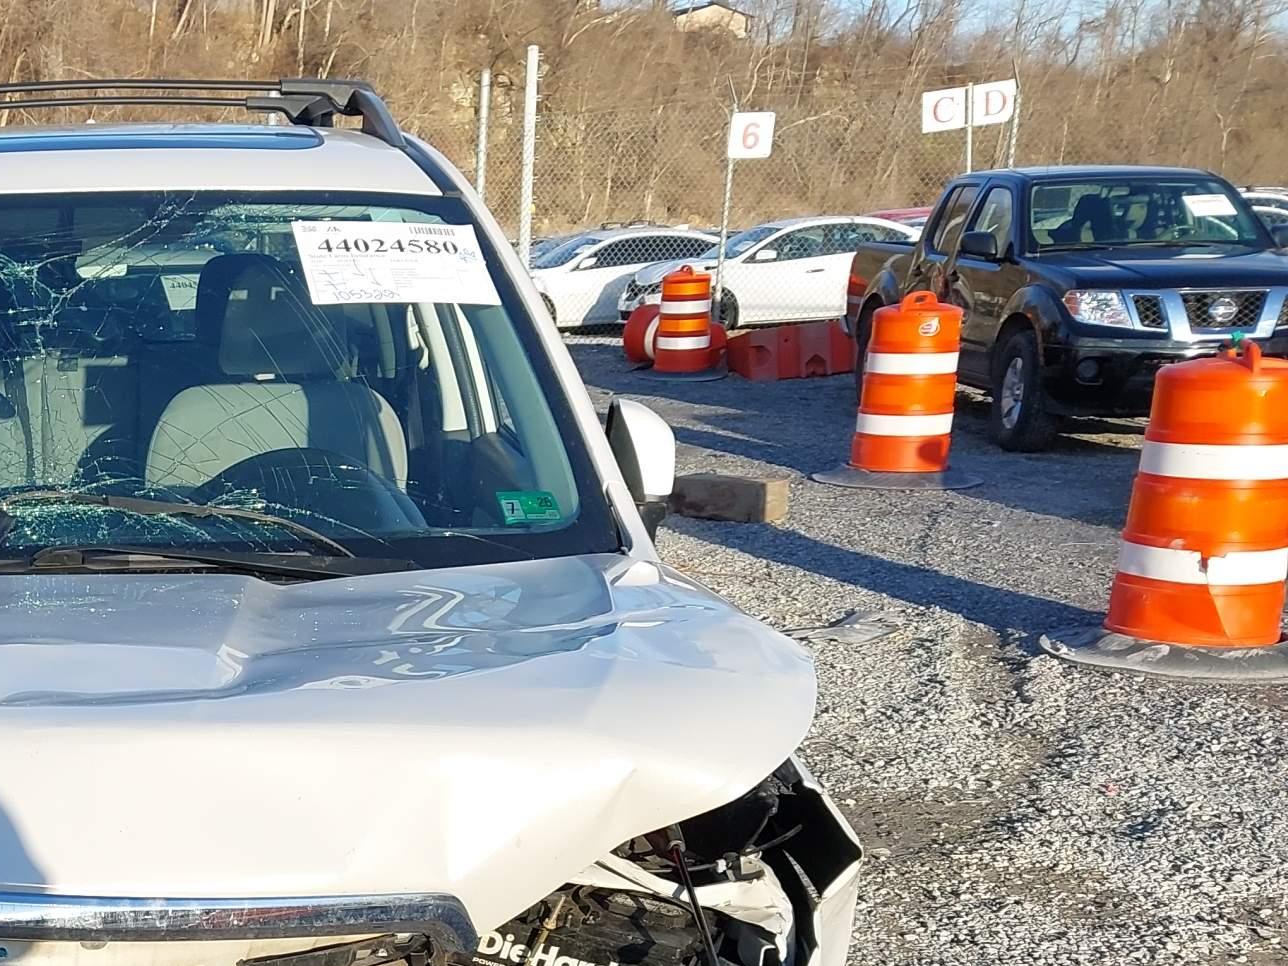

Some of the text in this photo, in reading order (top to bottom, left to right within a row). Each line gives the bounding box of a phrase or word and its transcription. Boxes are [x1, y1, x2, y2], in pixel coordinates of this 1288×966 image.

[932, 96, 955, 124] C
[983, 89, 1008, 117] D
[741, 121, 760, 150] 6
[318, 238, 458, 255] 44024580
[505, 502, 515, 515] 7
